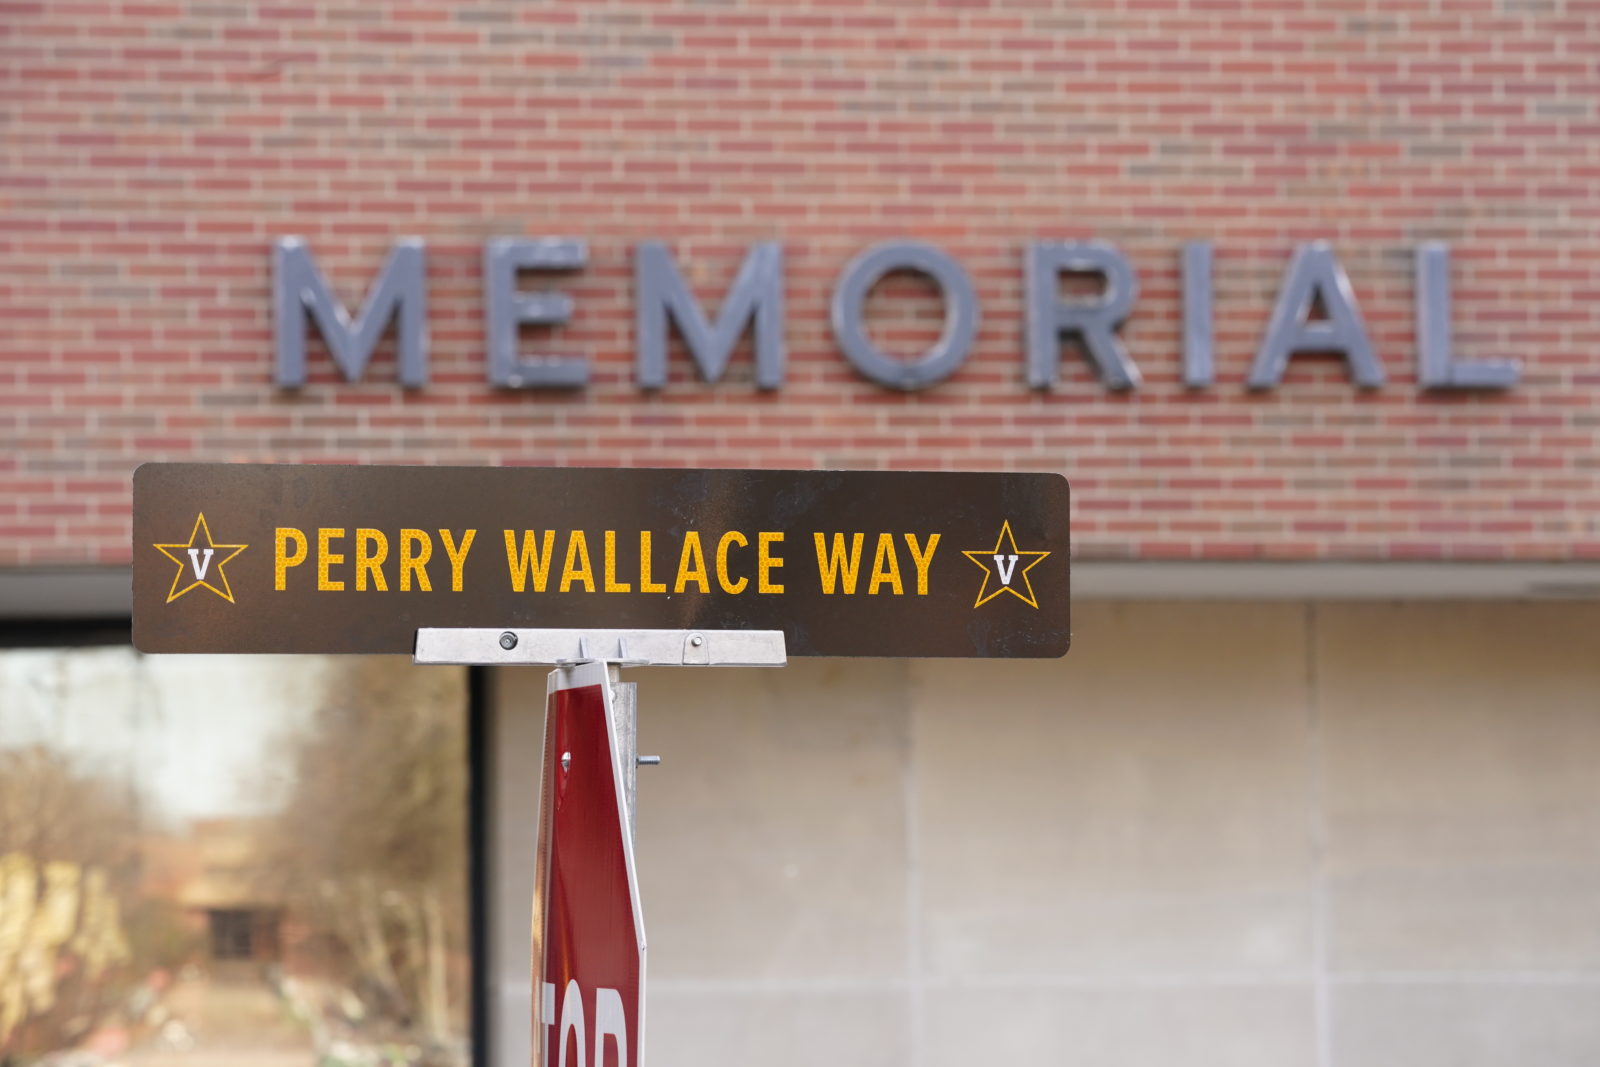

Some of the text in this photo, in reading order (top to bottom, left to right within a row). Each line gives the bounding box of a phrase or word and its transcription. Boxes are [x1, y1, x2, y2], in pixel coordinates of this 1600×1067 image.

[272, 235, 1521, 391] MEMORIAL
[187, 548, 214, 581] V
[274, 527, 941, 595] PERRY WALLACE WAY
[993, 554, 1019, 585] V
